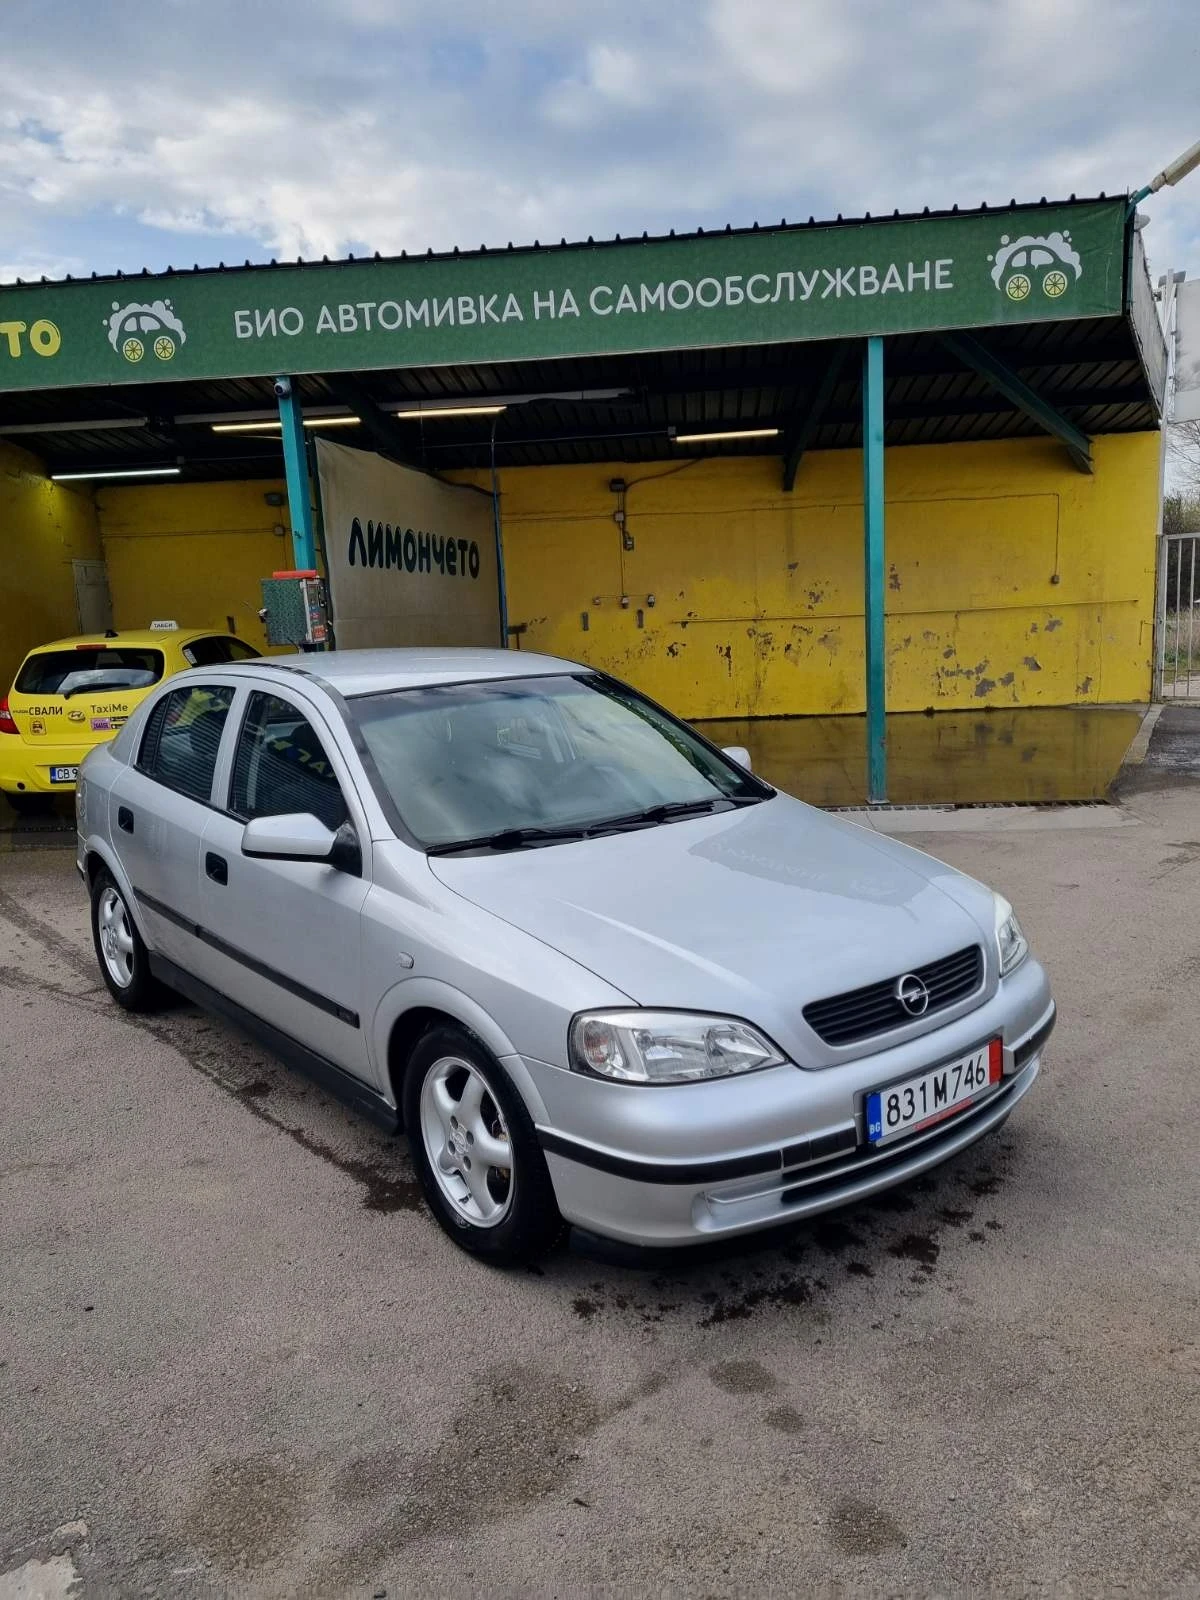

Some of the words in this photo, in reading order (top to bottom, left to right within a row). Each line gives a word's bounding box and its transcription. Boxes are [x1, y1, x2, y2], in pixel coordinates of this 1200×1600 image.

[234, 307, 304, 339] БИО
[315, 293, 524, 334] АВТОМИВКА
[533, 289, 580, 320] НА
[589, 258, 954, 316] САМООБСЛУЖВАНЕ
[28, 706, 63, 716] СВАЛИ
[91, 703, 129, 715] TaxiMe
[869, 1121, 881, 1135] BG
